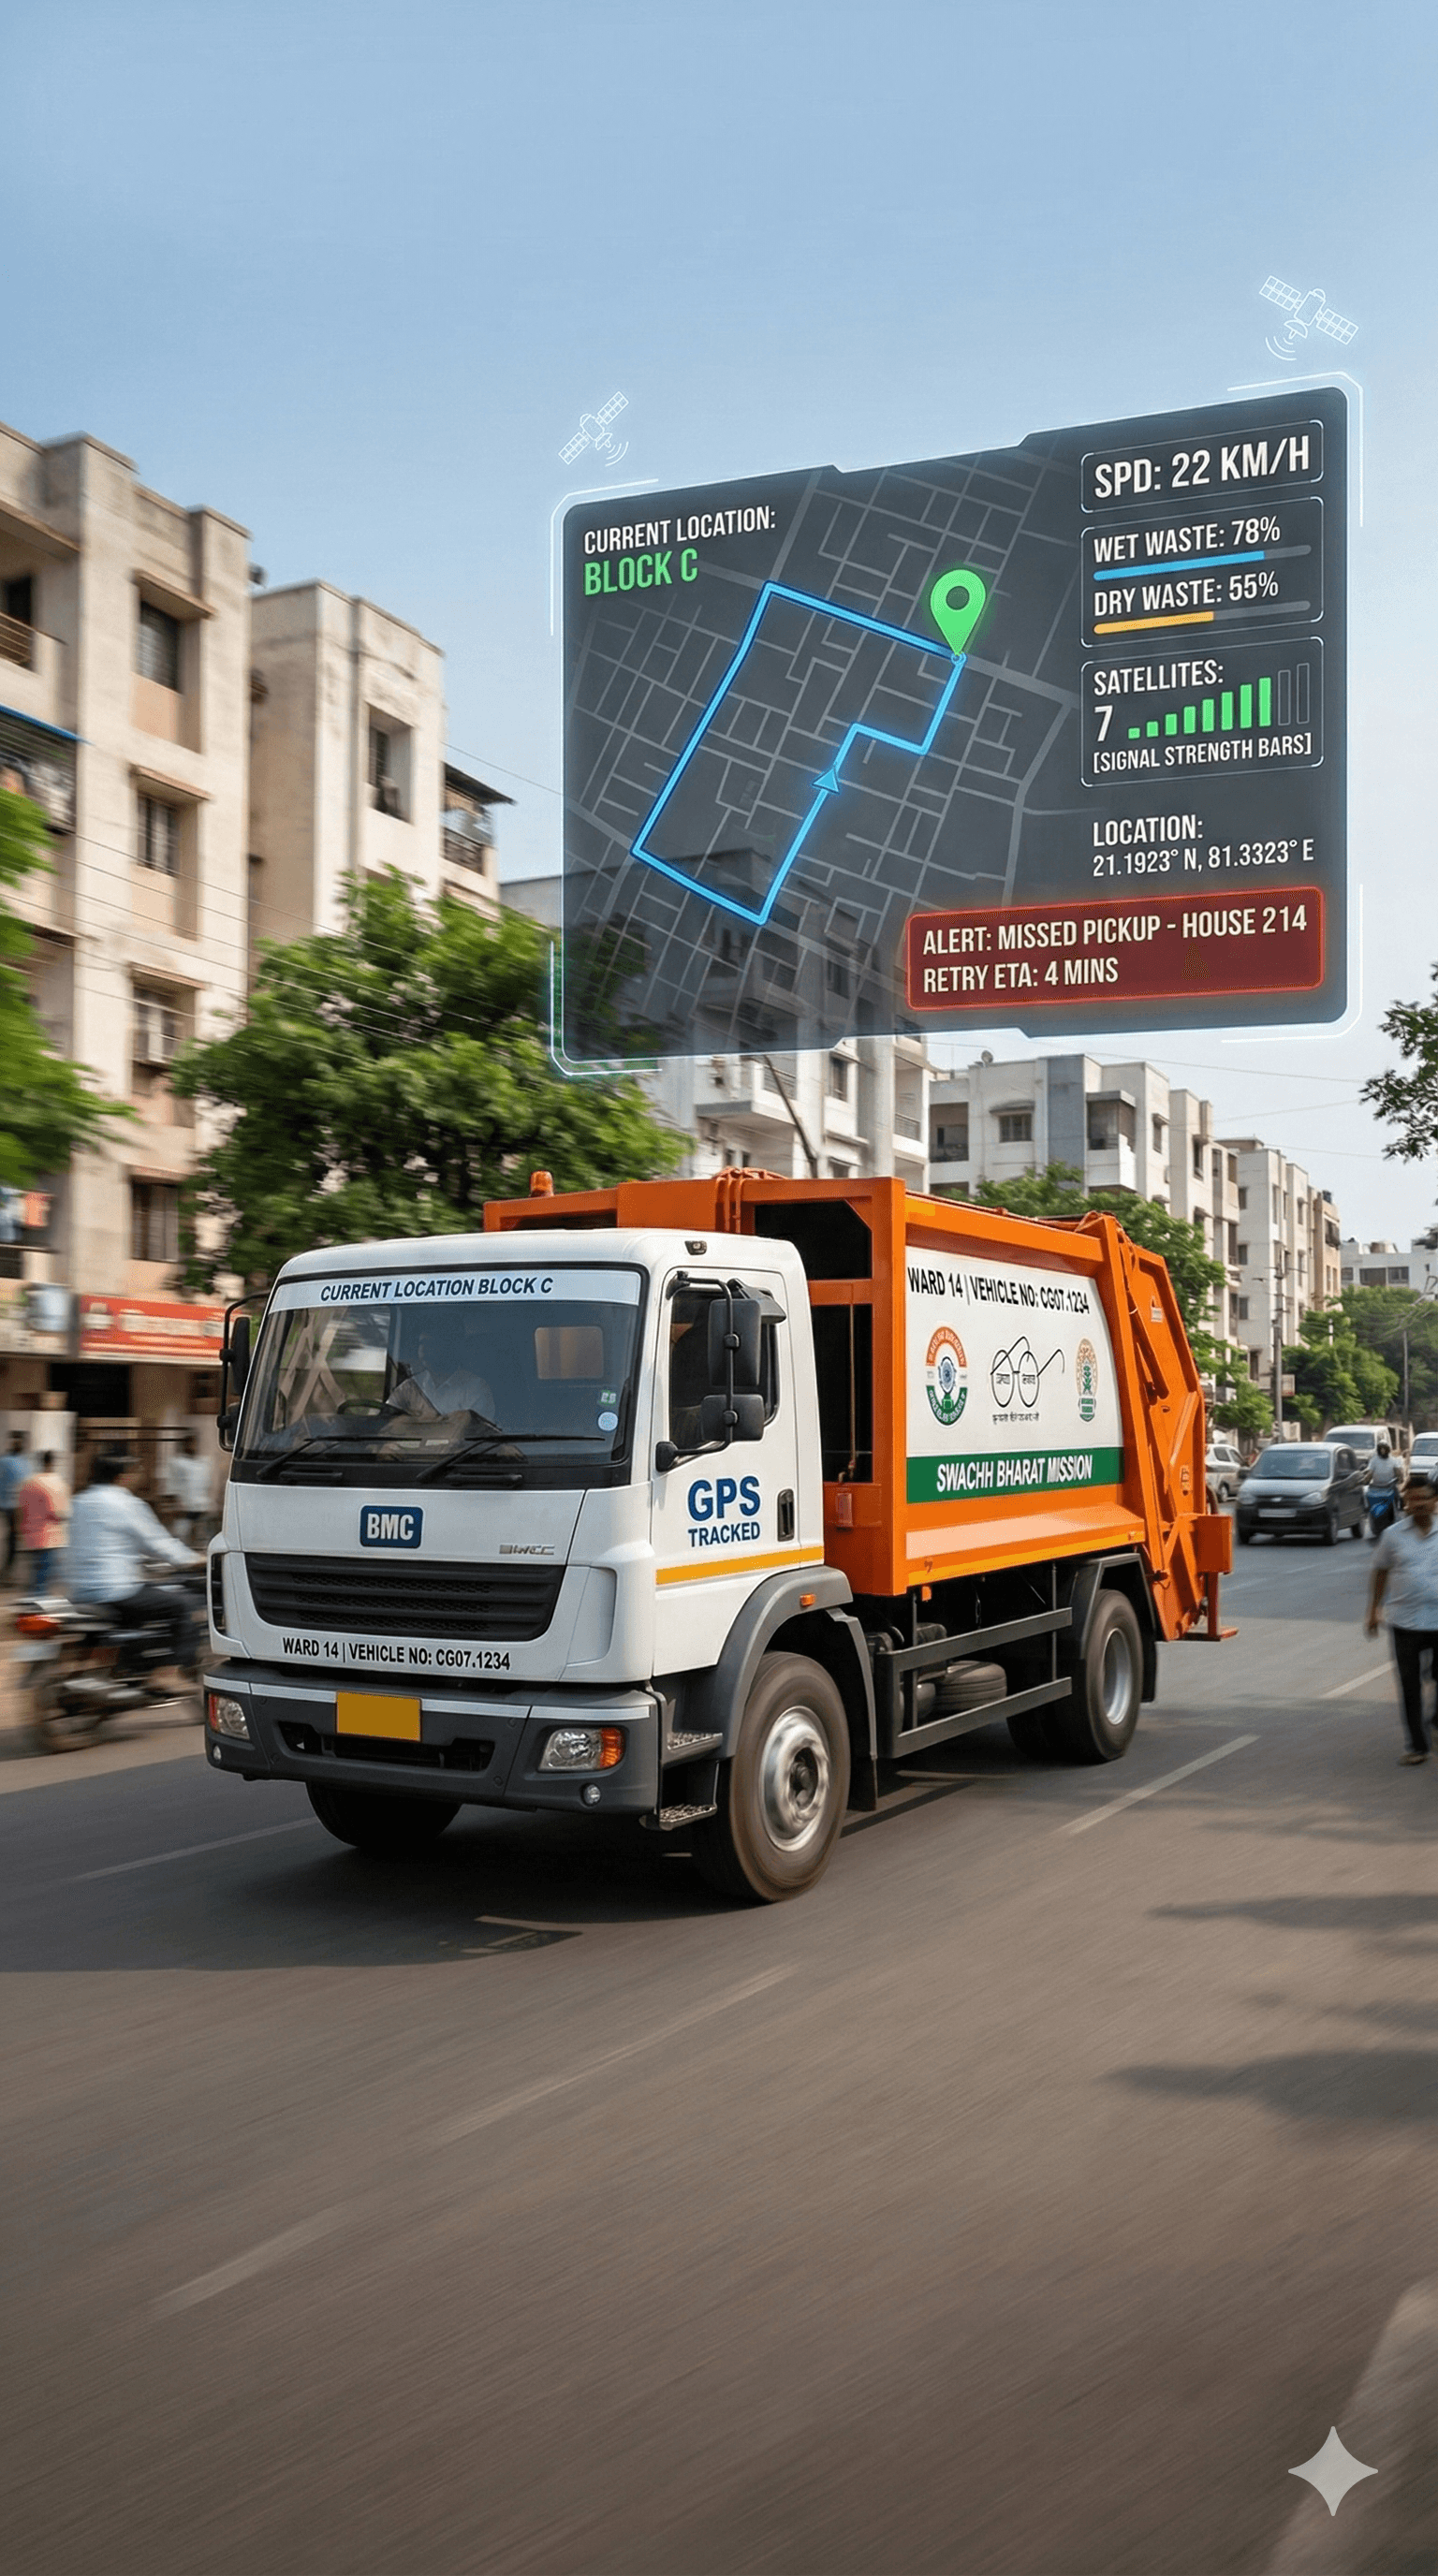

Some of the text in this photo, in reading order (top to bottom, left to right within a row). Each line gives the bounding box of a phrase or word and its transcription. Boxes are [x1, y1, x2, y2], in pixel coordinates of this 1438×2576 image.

[320, 1277, 553, 1301] CURRENT LOCATION BLOCK C
[907, 1266, 945, 1295] WARD
[948, 1273, 962, 1297] 14
[969, 1275, 1019, 1305] VEHICLE
[1019, 1283, 1038, 1308] NO:
[936, 1455, 1093, 1492] SWACHH BHARAT MISSION
[688, 1475, 761, 1521] GPS
[367, 1513, 414, 1541] BMC
[688, 1521, 760, 1547] TRACKED
[283, 1637, 319, 1656] WARD
[323, 1641, 339, 1659] 14
[348, 1643, 404, 1662] VEHICLE
[408, 1646, 432, 1665] NO:
[436, 1648, 510, 1670] CG07.1234
